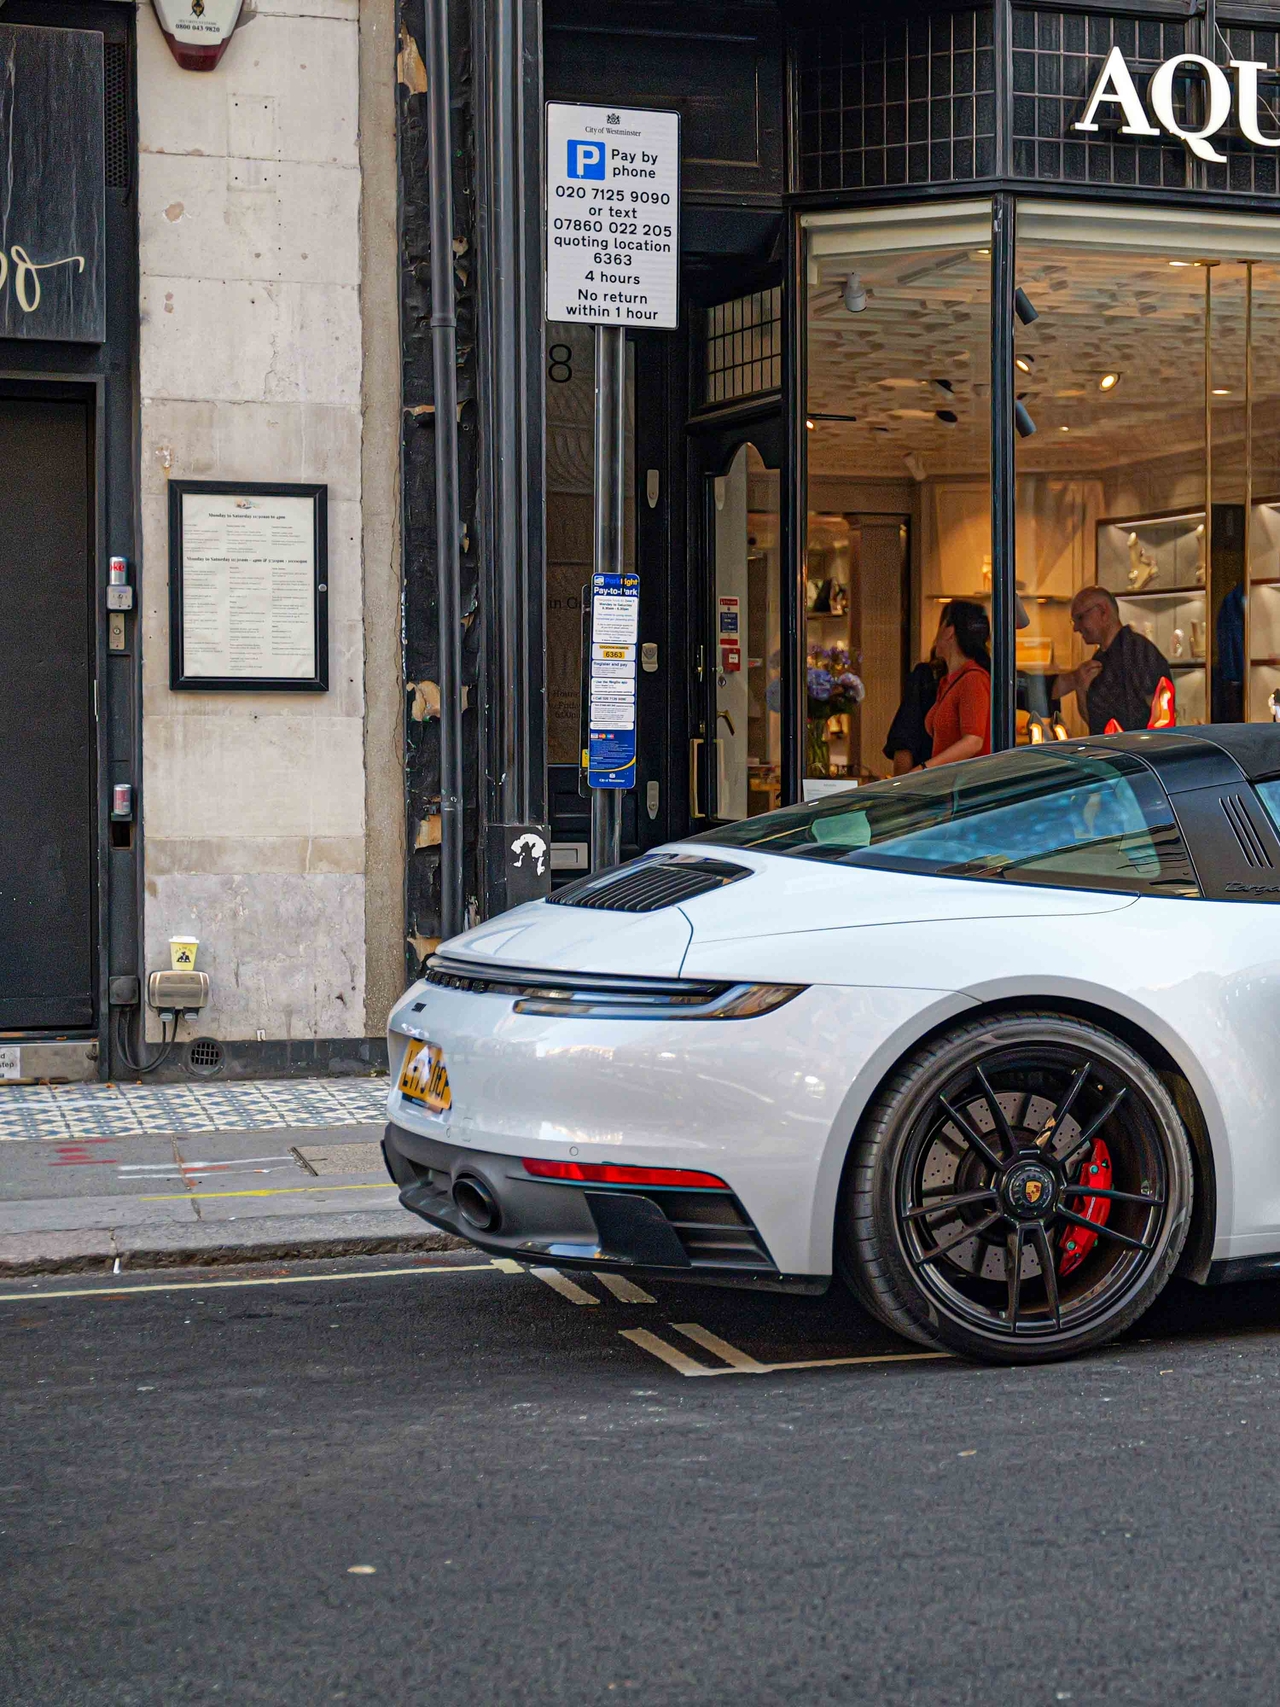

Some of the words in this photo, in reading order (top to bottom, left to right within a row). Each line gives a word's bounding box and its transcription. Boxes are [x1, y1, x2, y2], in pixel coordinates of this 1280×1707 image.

[584, 126, 598, 134] City
[606, 127, 642, 137] Westminster
[576, 144, 599, 175] P
[611, 149, 636, 164] Pay
[642, 150, 658, 165] by
[612, 164, 656, 178] phone
[556, 185, 586, 199] 020
[592, 188, 625, 202] 7125
[630, 191, 670, 205] 9090
[589, 207, 603, 216] or
[609, 206, 637, 218] text
[554, 218, 602, 232] 07860
[609, 221, 637, 235] 022
[643, 224, 672, 237] 205
[554, 236, 608, 250] quoting
[614, 238, 671, 252] location
[594, 252, 632, 266] 6363
[585, 270, 595, 281] 4
[601, 272, 640, 285] hours
[578, 289, 598, 302] No
[604, 292, 648, 304] return
[566, 305, 610, 318] within
[616, 306, 621, 318] 1
[626, 307, 658, 320] hour
[548, 344, 572, 383] 8
